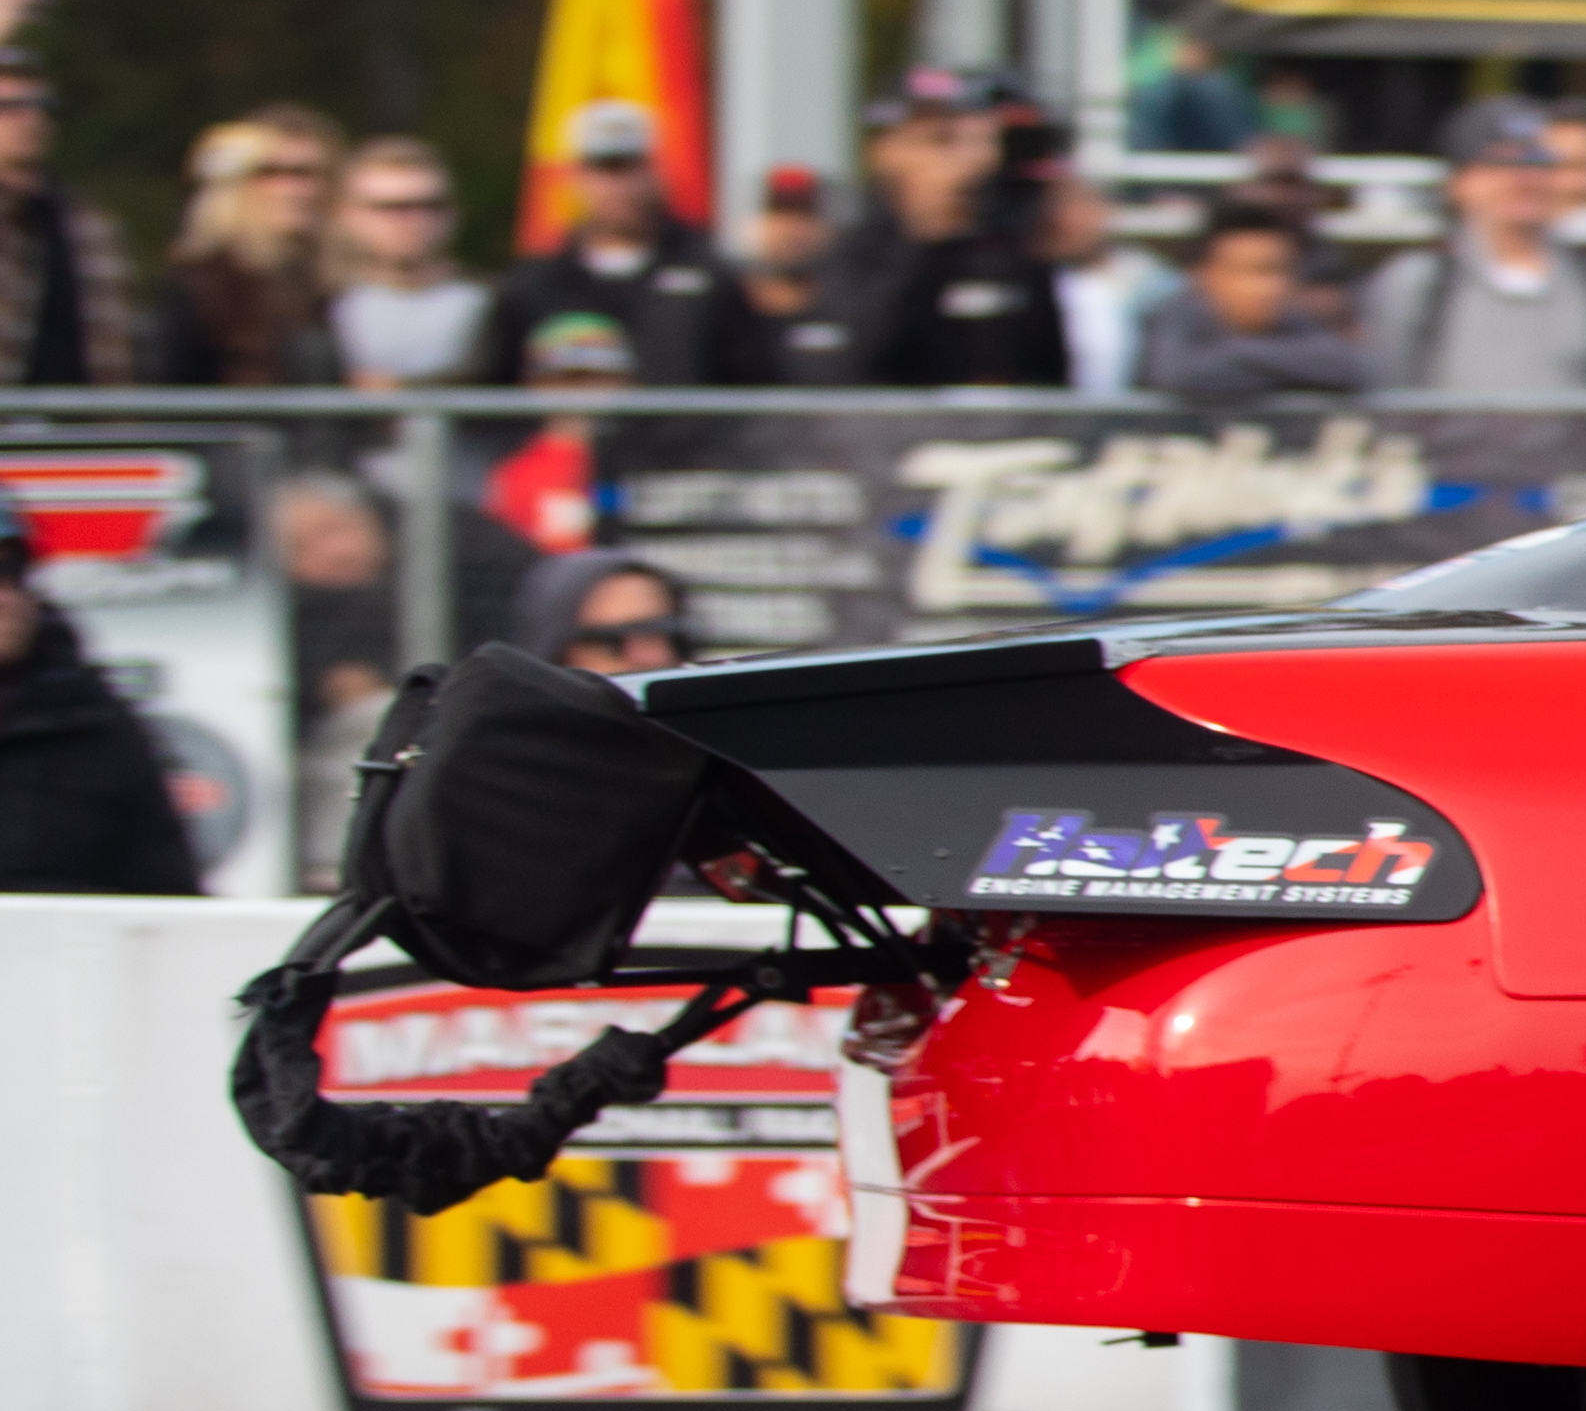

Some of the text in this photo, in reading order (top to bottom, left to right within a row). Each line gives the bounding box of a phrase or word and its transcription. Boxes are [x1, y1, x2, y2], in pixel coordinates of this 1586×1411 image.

[984, 812, 1437, 885] Haltech
[971, 876, 1413, 905] ENGINE MANAGEMENT SYSTEMS
